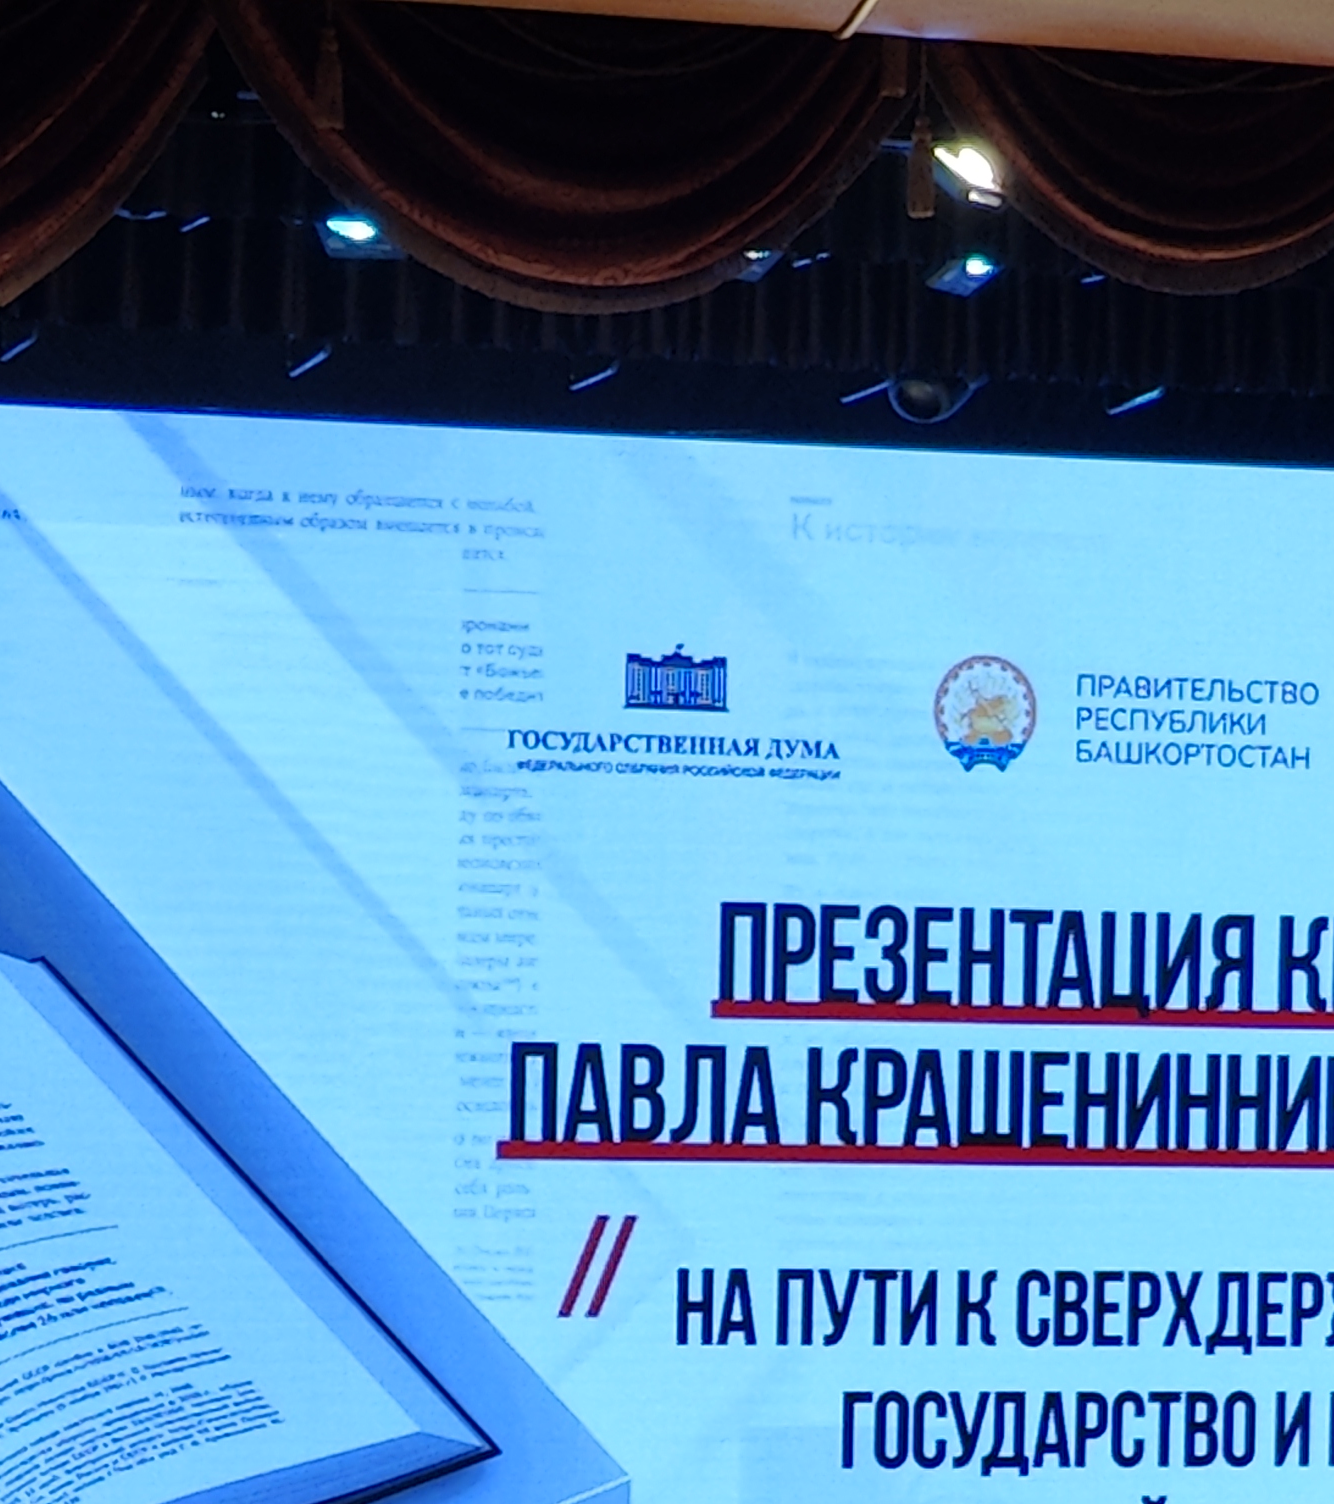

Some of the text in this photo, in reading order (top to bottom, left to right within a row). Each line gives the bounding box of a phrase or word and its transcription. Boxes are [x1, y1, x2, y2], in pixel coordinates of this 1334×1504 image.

[1077, 674, 1319, 711] ПРАВИТЕЛЬСТВО
[508, 729, 840, 760] ГОСУДАРСТВЕННАЯ ДУМА
[1076, 706, 1267, 738] РЕСПУБЛИКИ
[1076, 739, 1312, 772] БАШКОРТОСТАН
[718, 902, 1257, 1017] ПРЕЗЕНТАЦИЯ
[510, 1041, 780, 1143] ПАВЛА
[676, 1267, 757, 1346] НА
[776, 1268, 938, 1347] ПУТИ
[956, 1269, 998, 1346] К
[841, 1390, 1256, 1477] ГОСУДАРСТВО
[1274, 1391, 1312, 1467] И
